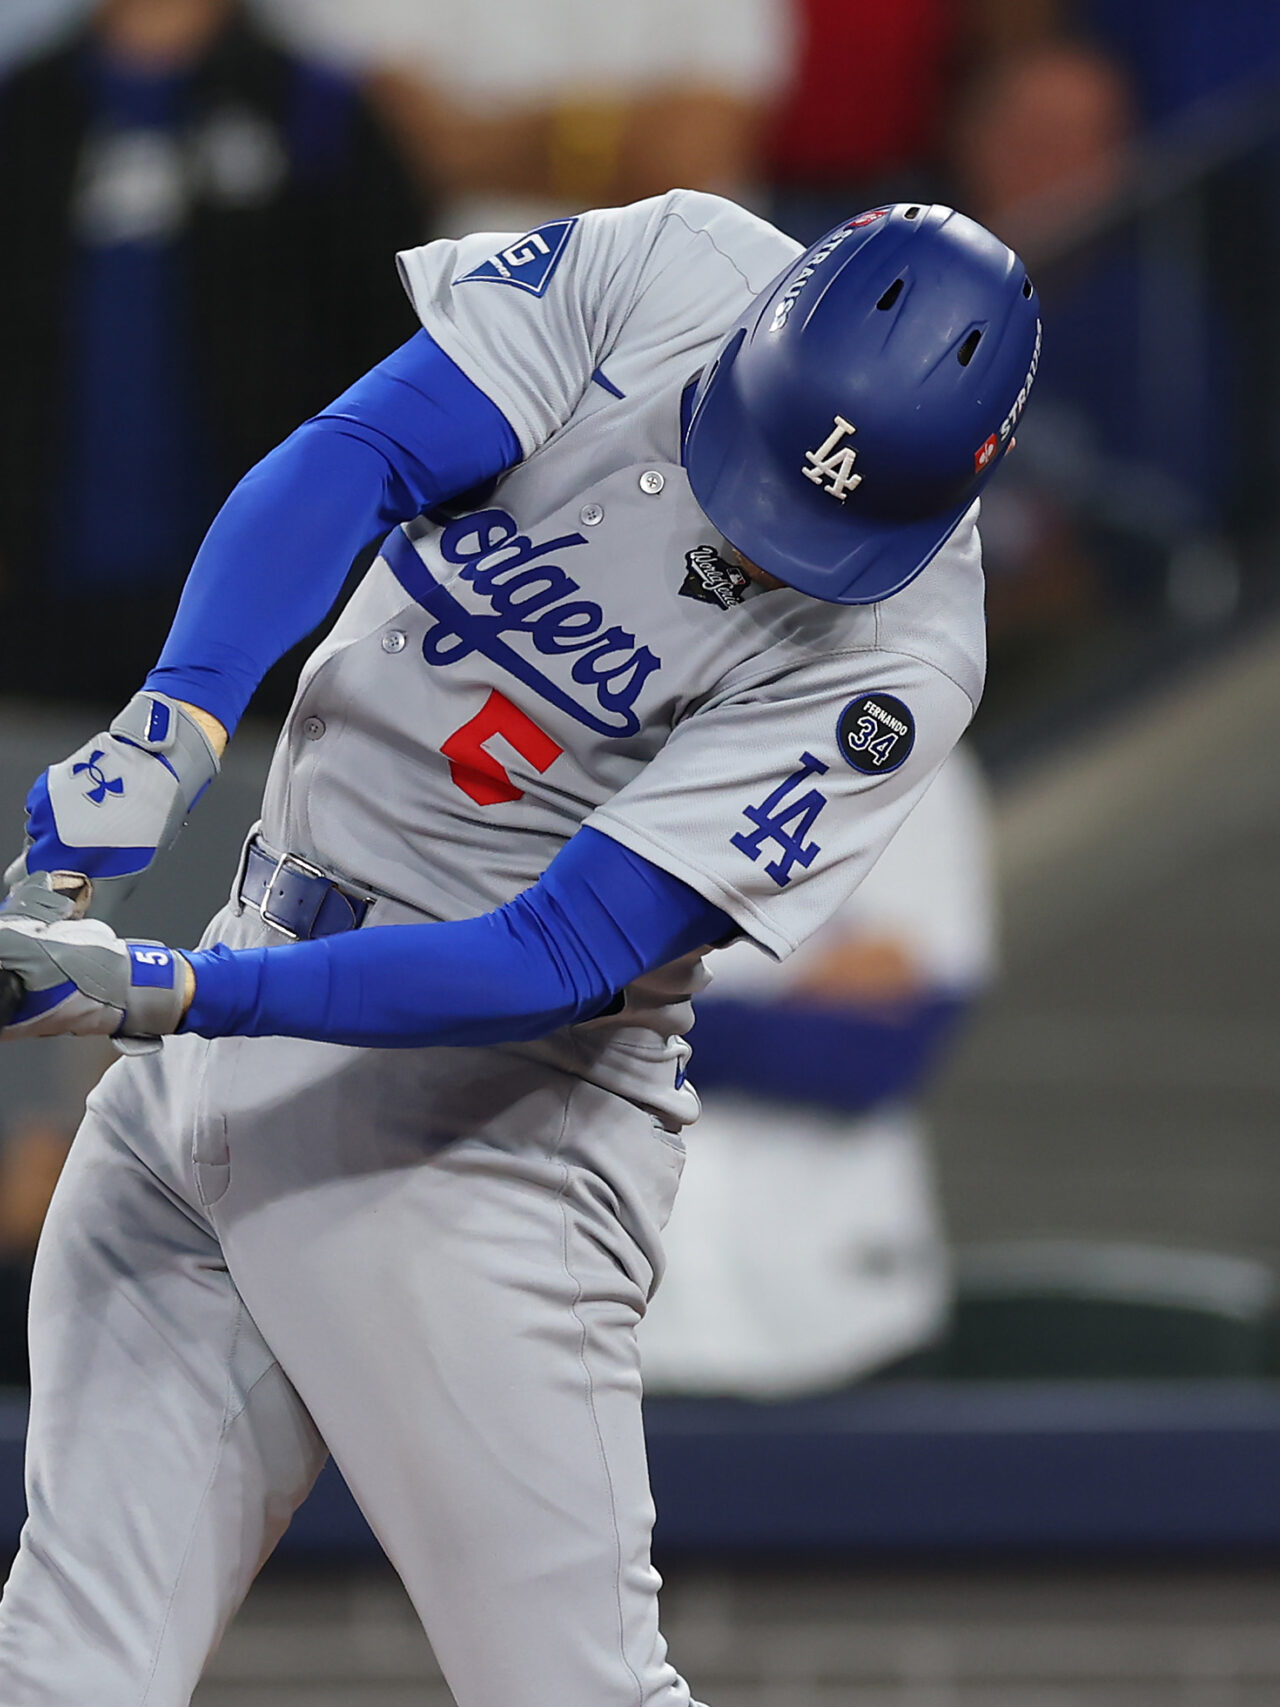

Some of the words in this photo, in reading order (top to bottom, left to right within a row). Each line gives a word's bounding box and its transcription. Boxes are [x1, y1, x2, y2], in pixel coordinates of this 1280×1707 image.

[769, 228, 854, 333] STRAUSS
[801, 415, 863, 500] LA
[690, 546, 728, 585] World
[701, 582, 741, 610] Serie
[423, 507, 662, 738] odgers
[440, 688, 565, 807] 5
[848, 716, 899, 766] 34
[863, 700, 908, 736] FERNANDO
[729, 751, 830, 888] LA
[134, 951, 169, 966] 5
